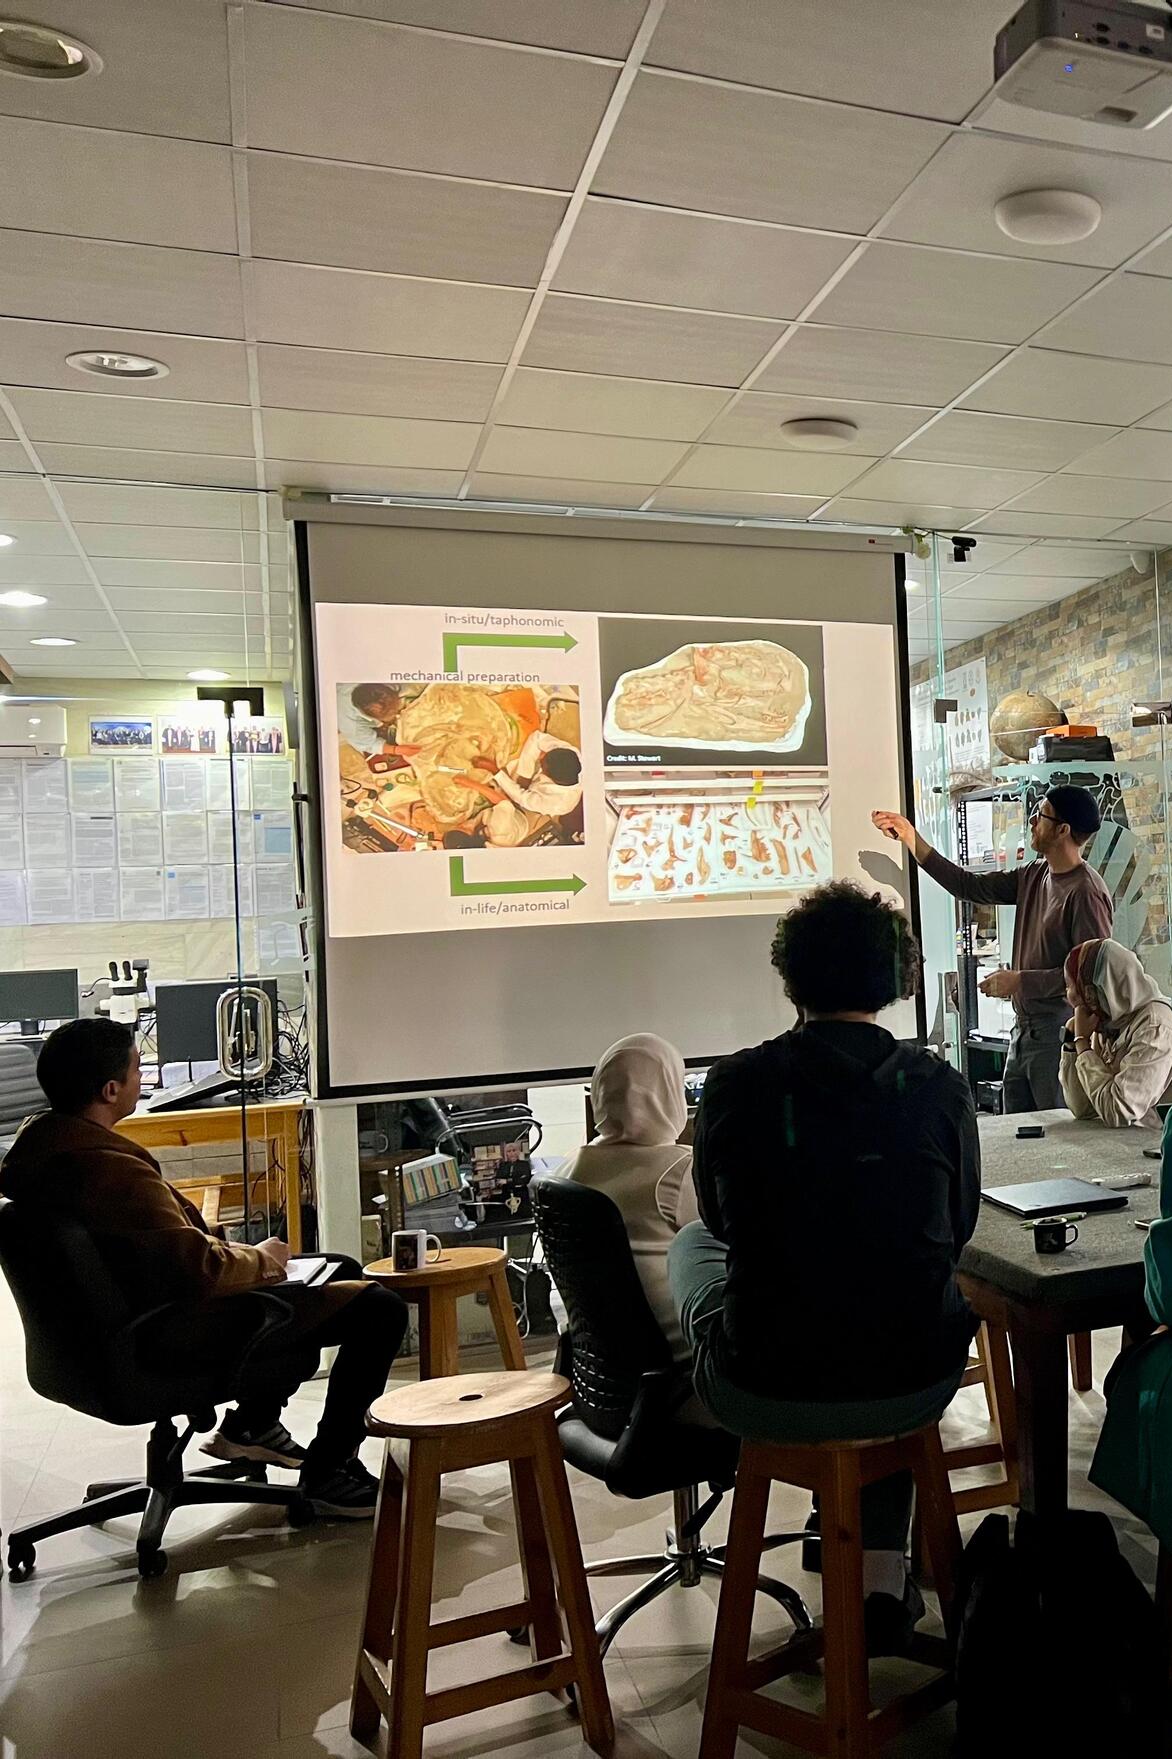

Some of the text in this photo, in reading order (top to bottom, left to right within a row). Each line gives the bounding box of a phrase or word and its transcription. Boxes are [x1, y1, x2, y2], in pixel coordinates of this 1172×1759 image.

[444, 613, 565, 628] in-situ/taphonomic
[390, 670, 540, 684] mechanical preparation
[461, 899, 570, 915] in-life/anatomical
